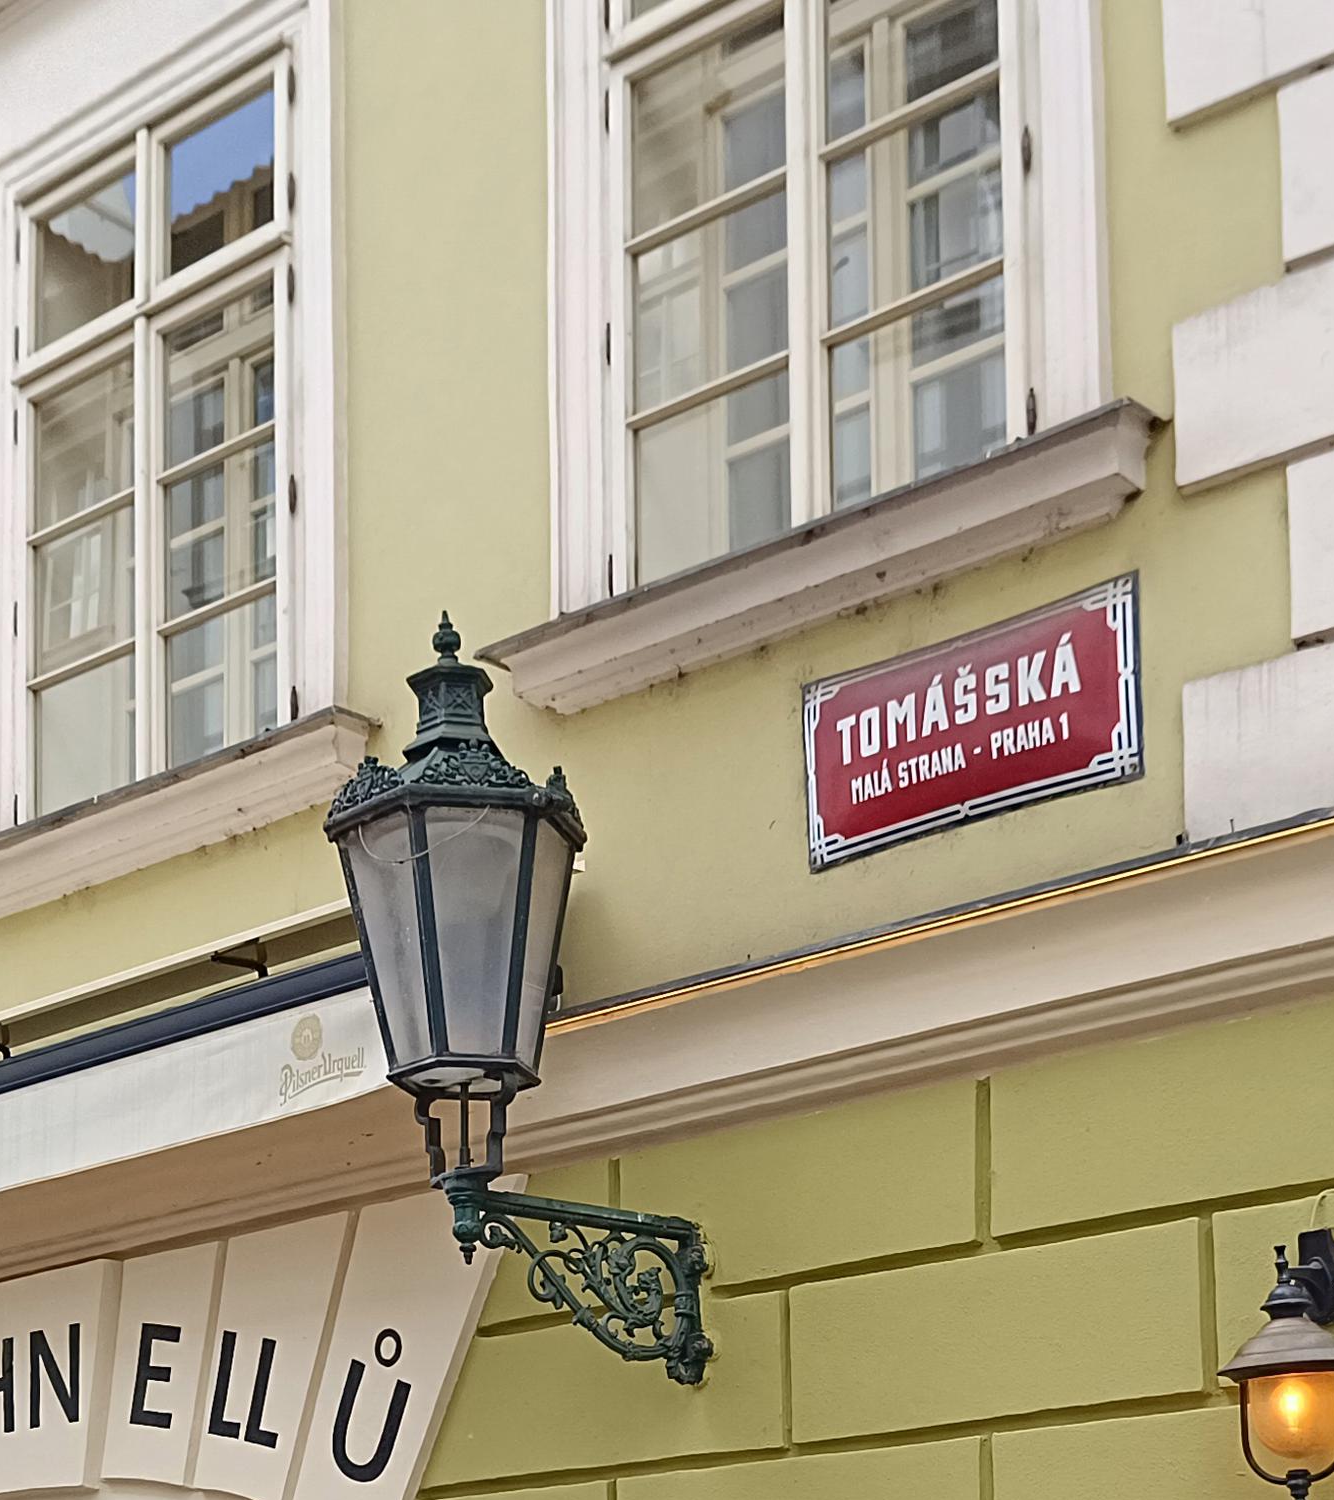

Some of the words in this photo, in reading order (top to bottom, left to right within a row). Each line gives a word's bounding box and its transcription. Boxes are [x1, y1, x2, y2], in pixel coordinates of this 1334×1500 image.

[837, 631, 1082, 765] TOMÁŠSKÁ
[851, 759, 893, 804] MALÁ
[898, 743, 966, 789] STRANA
[991, 722, 1056, 759] PRAHA
[1059, 712, 1069, 740] 1
